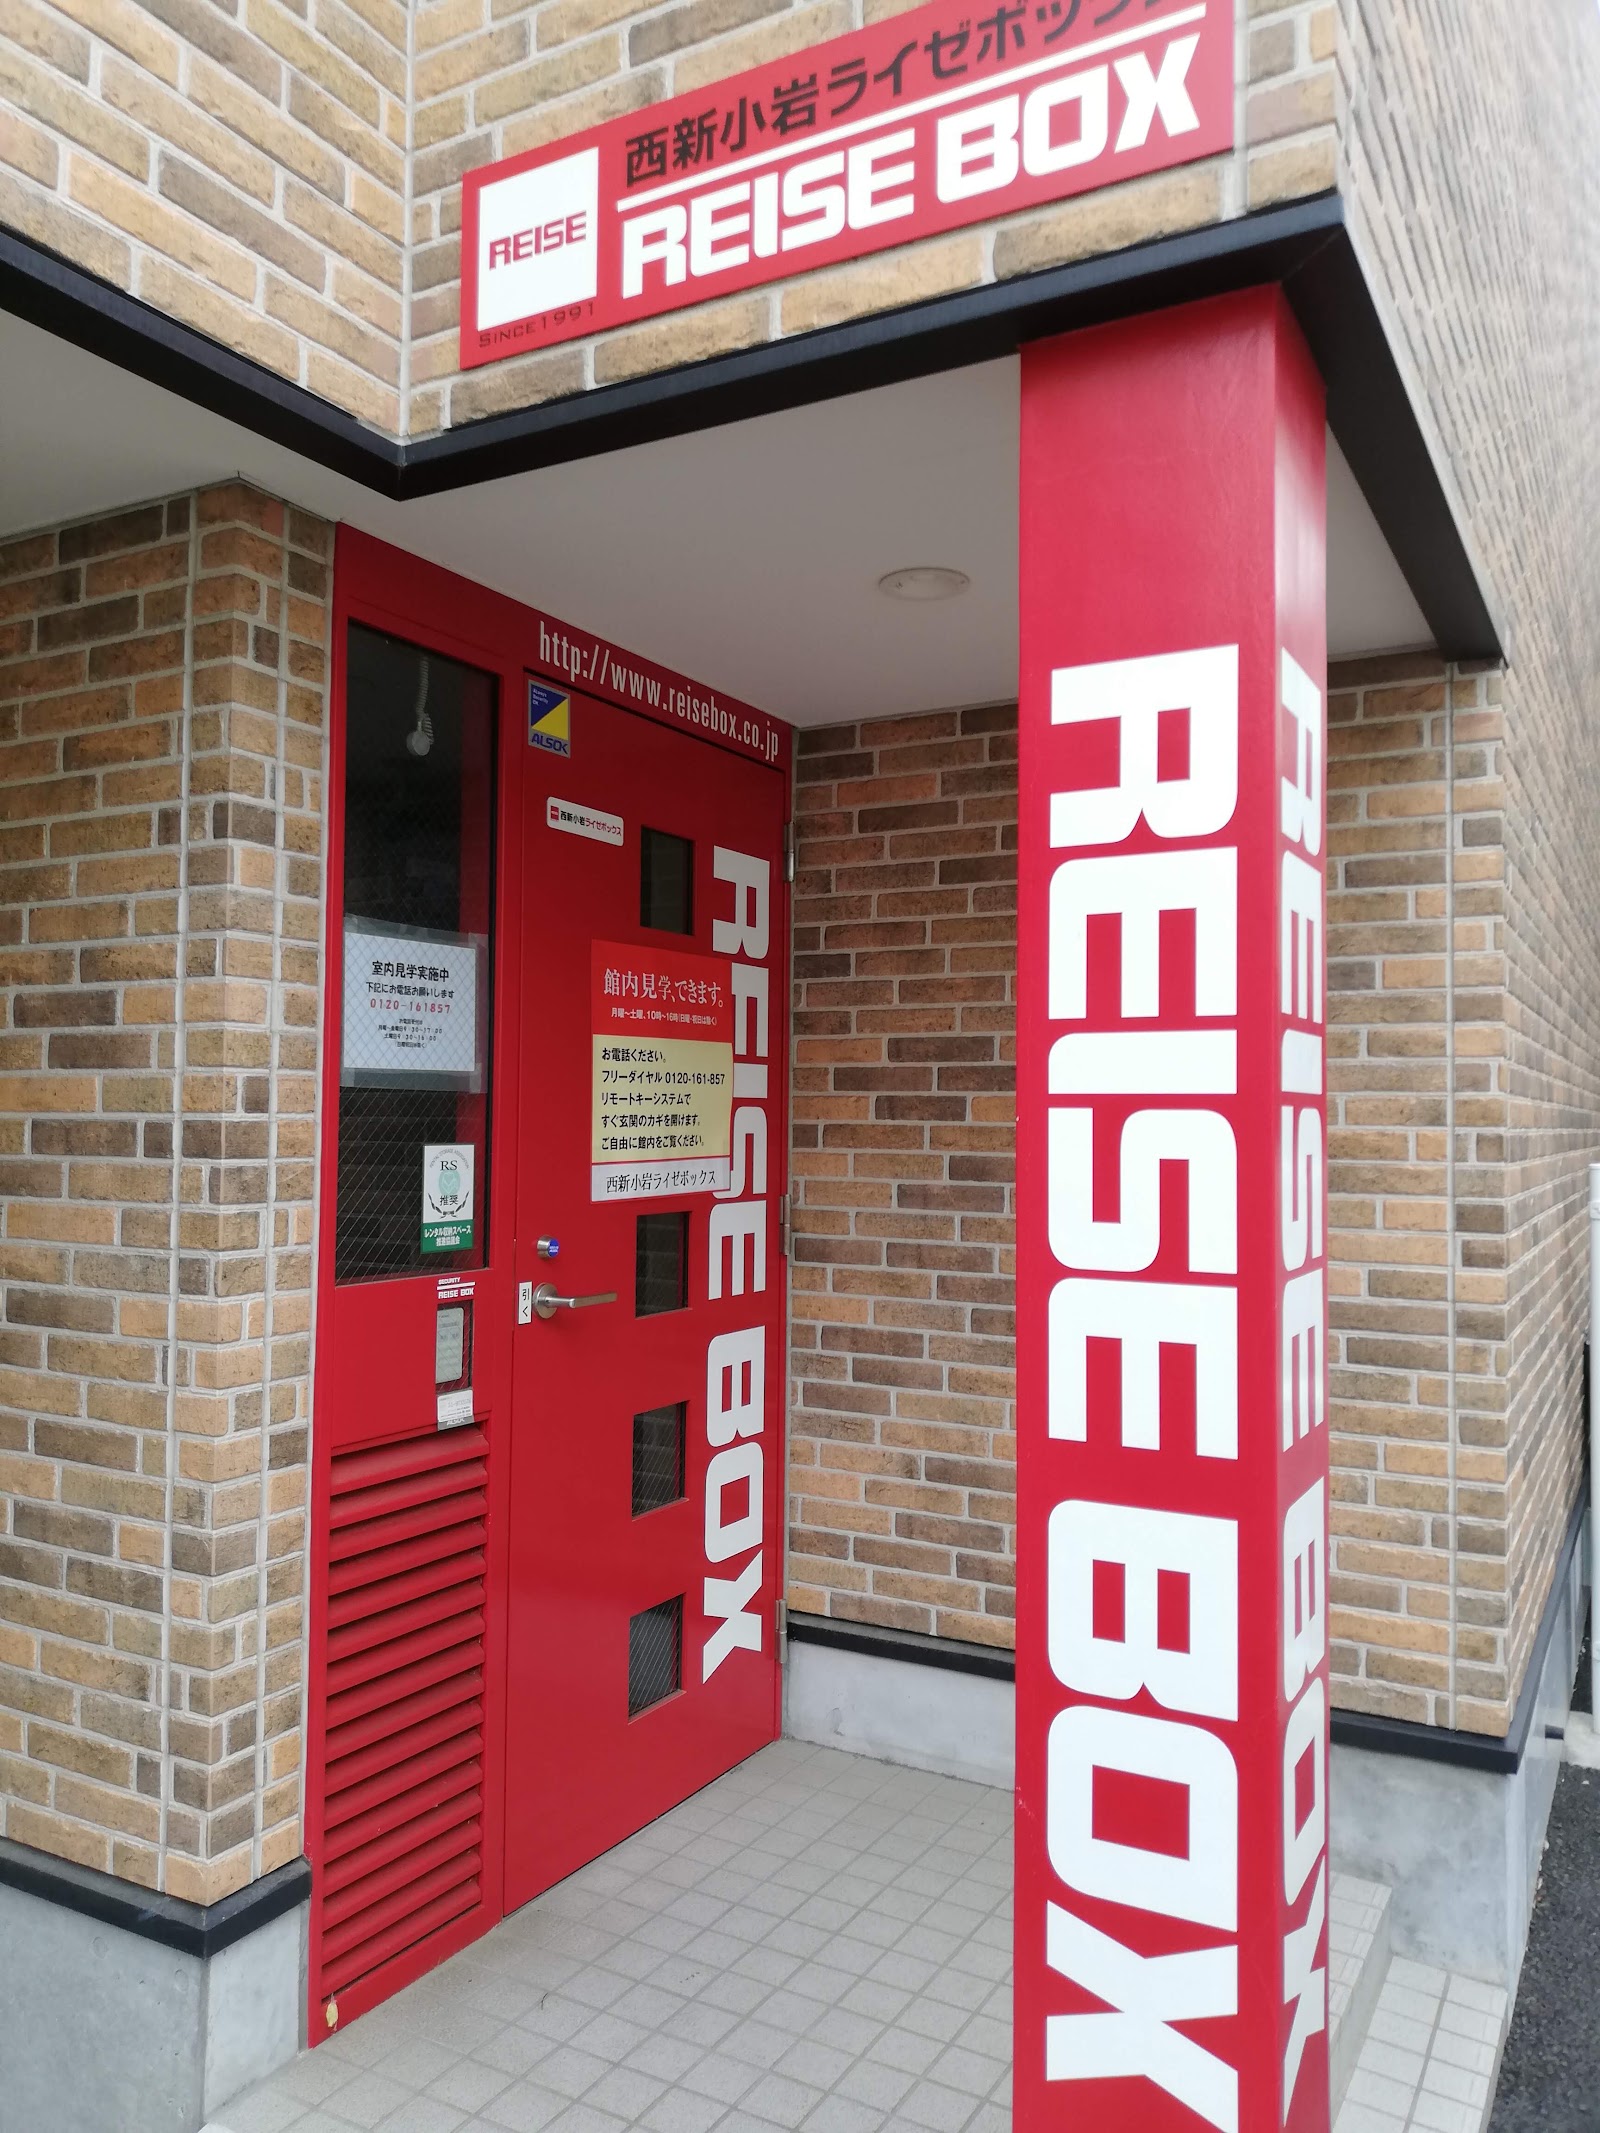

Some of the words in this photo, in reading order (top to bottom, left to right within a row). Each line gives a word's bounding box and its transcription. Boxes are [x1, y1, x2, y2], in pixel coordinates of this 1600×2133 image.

[625, 0, 1162, 188] 西新小岩ライゼボッ
[622, 128, 916, 299] REISE
[936, 32, 1200, 203] BOX
[489, 210, 587, 271] REISE
[539, 620, 779, 763] http://www.reisebox.co.jp
[531, 733, 569, 755] ALSOK
[560, 810, 622, 837] 西新小岩ライゼボックス
[372, 960, 450, 983] 室内見学実施中
[366, 981, 455, 999] 下記にお電話お願いします
[603, 967, 724, 1008] 館内見学、できます。
[601, 1047, 667, 1063] お電話ください。
[1047, 644, 1239, 1460] REISE
[1281, 646, 1326, 1453] REISE
[602, 1070, 663, 1084] フリーダイヤル
[665, 1071, 725, 1085] 0120-161-857
[708, 845, 771, 1300] REISE
[601, 1092, 691, 1106] リモートキーシステムで
[601, 1113, 700, 1129] すぐ玄関のカギを開けます。
[601, 1135, 704, 1151] ご自由に館内をご覧ください。
[440, 1160, 458, 1171] RS
[606, 1168, 716, 1194] 西新小岩ライゼボックス
[439, 1194, 459, 1207] 推奨
[438, 1290, 459, 1299] REISE
[460, 1288, 474, 1297] BOX
[522, 1288, 530, 1317] 引く
[702, 1325, 767, 1683] BOX
[1283, 1476, 1326, 2128] BOX
[1046, 1499, 1239, 2133] BOX
